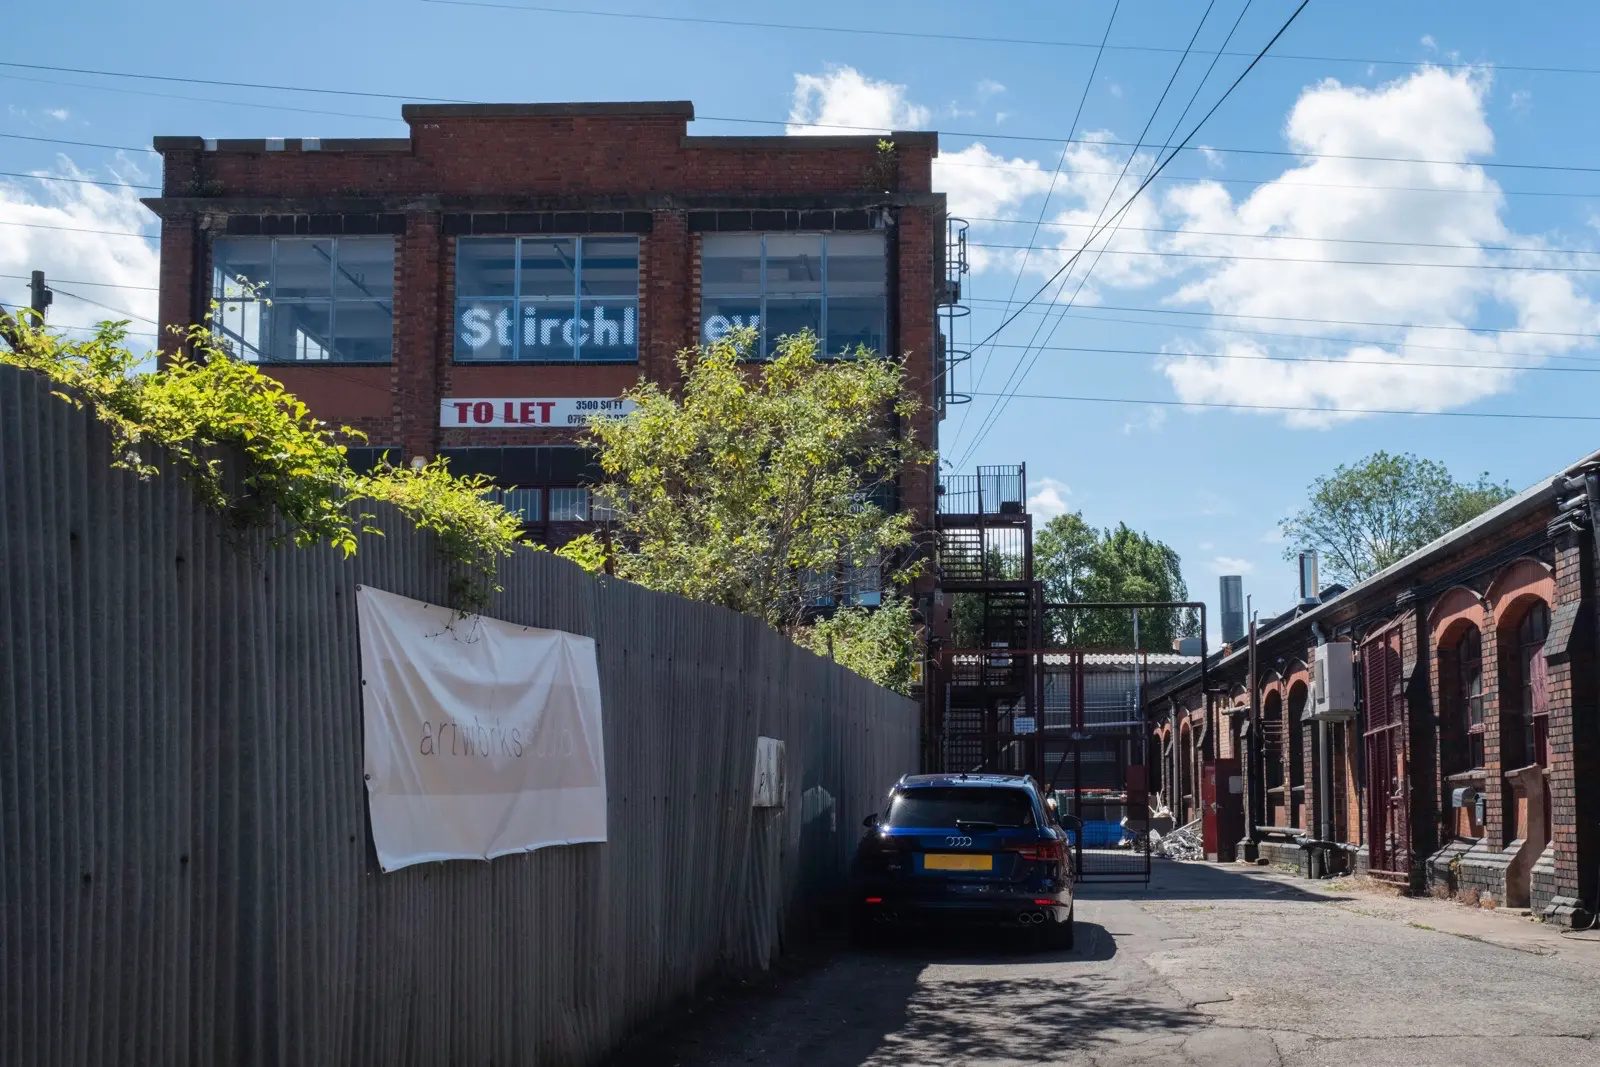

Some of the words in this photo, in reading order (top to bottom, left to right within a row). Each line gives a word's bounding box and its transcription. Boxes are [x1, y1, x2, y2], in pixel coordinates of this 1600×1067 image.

[454, 402, 494, 424] TO
[504, 402, 556, 423] LET
[576, 400, 598, 410] 3500
[601, 400, 612, 411] SQ
[614, 400, 623, 410] FT
[420, 715, 523, 758] artworks
